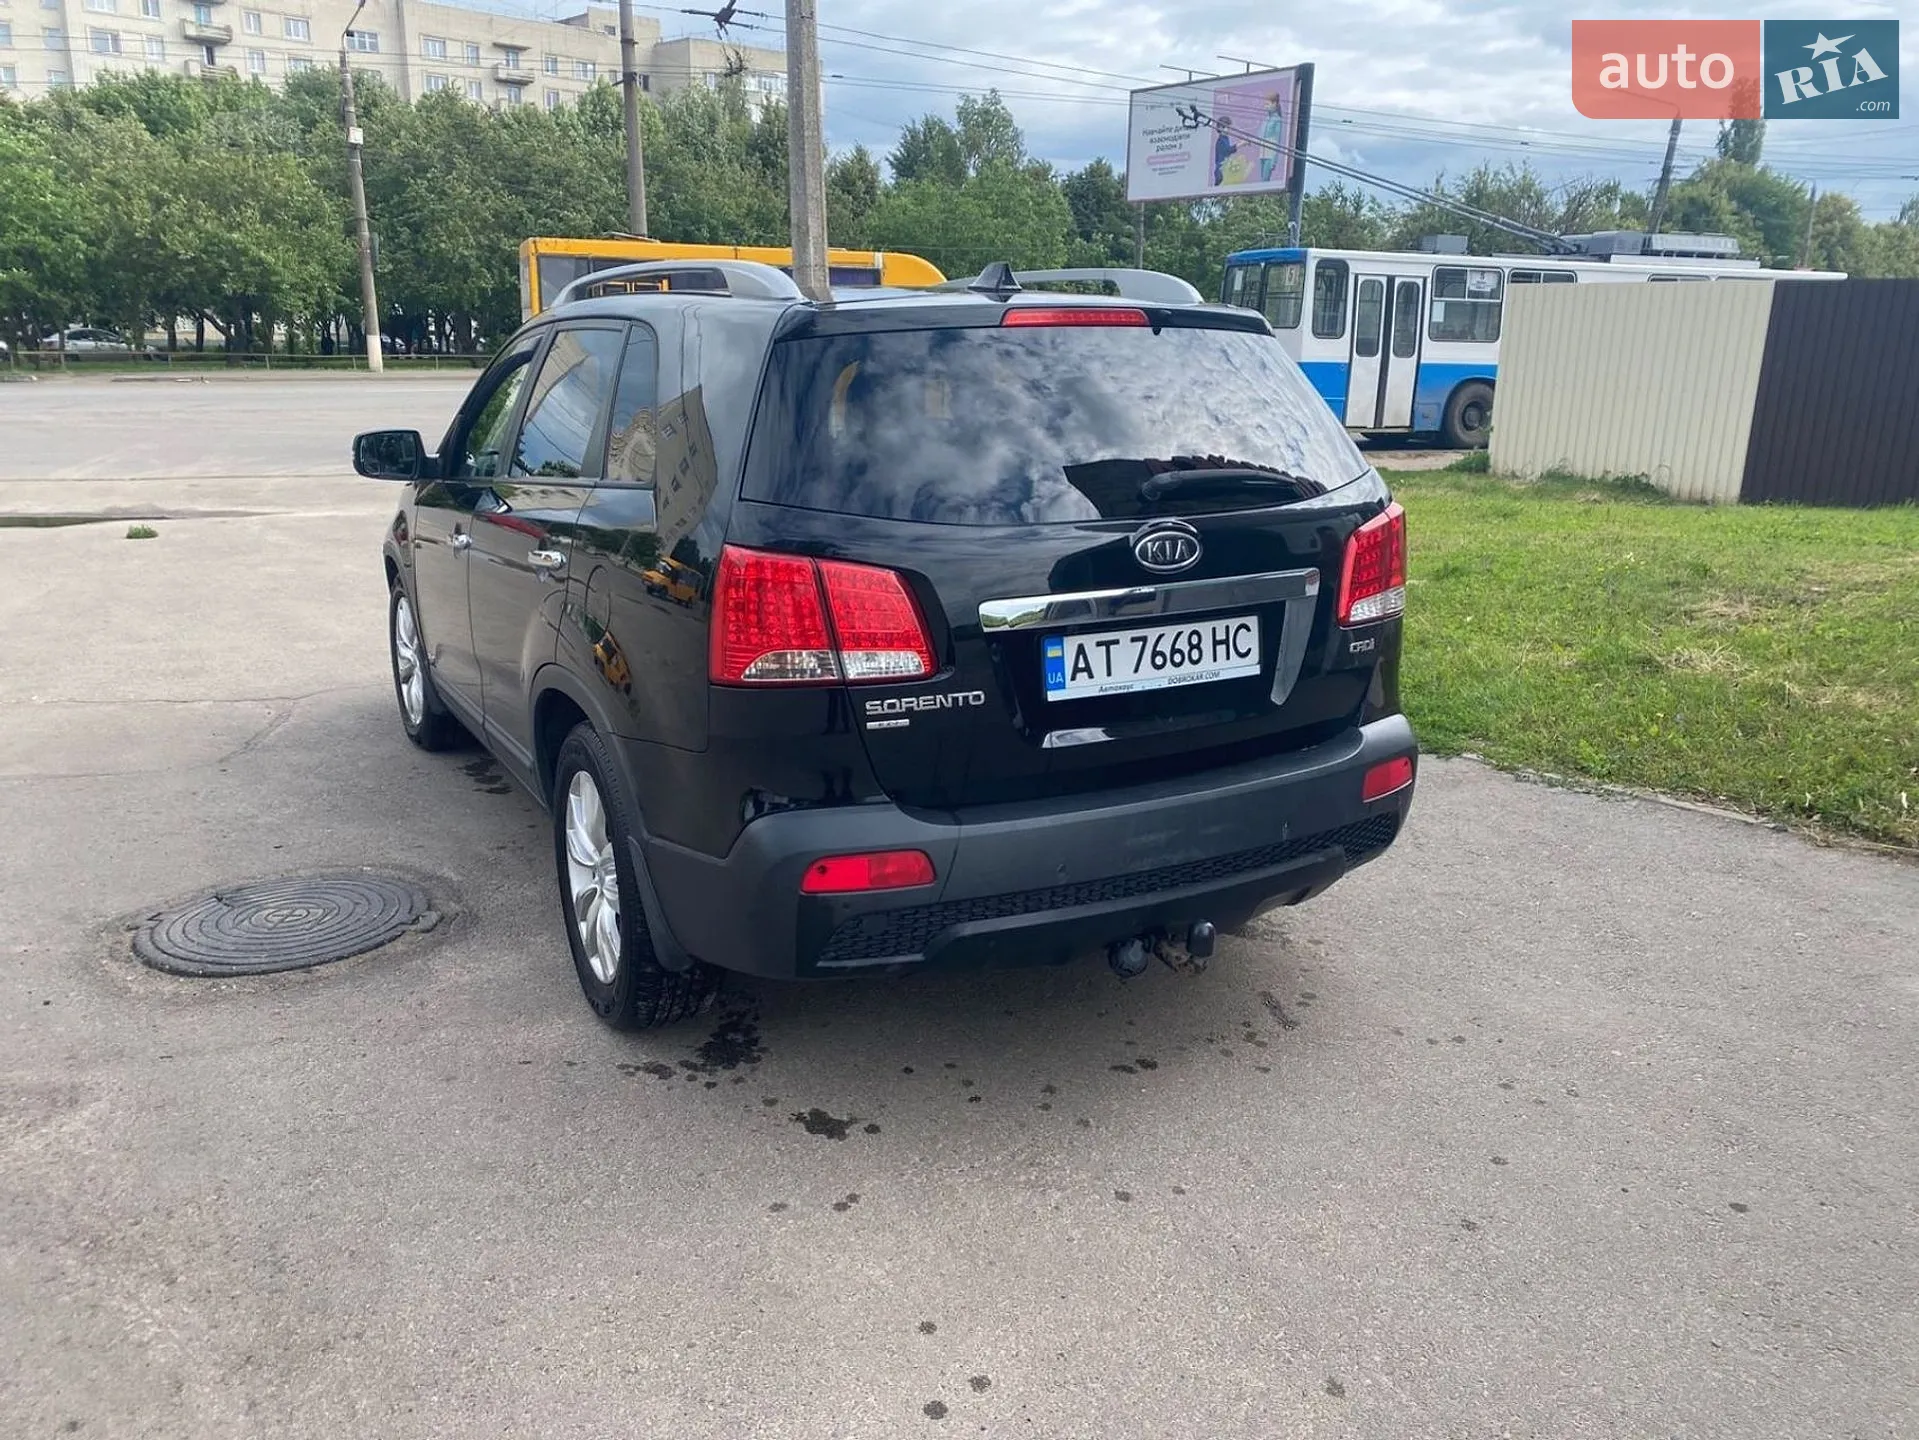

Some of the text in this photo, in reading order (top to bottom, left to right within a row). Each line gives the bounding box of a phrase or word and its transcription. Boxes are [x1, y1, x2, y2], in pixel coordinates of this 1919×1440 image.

[1146, 539, 1189, 562] KIA
[1070, 623, 1252, 682] AT 7668 HC
[1047, 672, 1064, 685] UA
[865, 690, 985, 715] SORENTO
